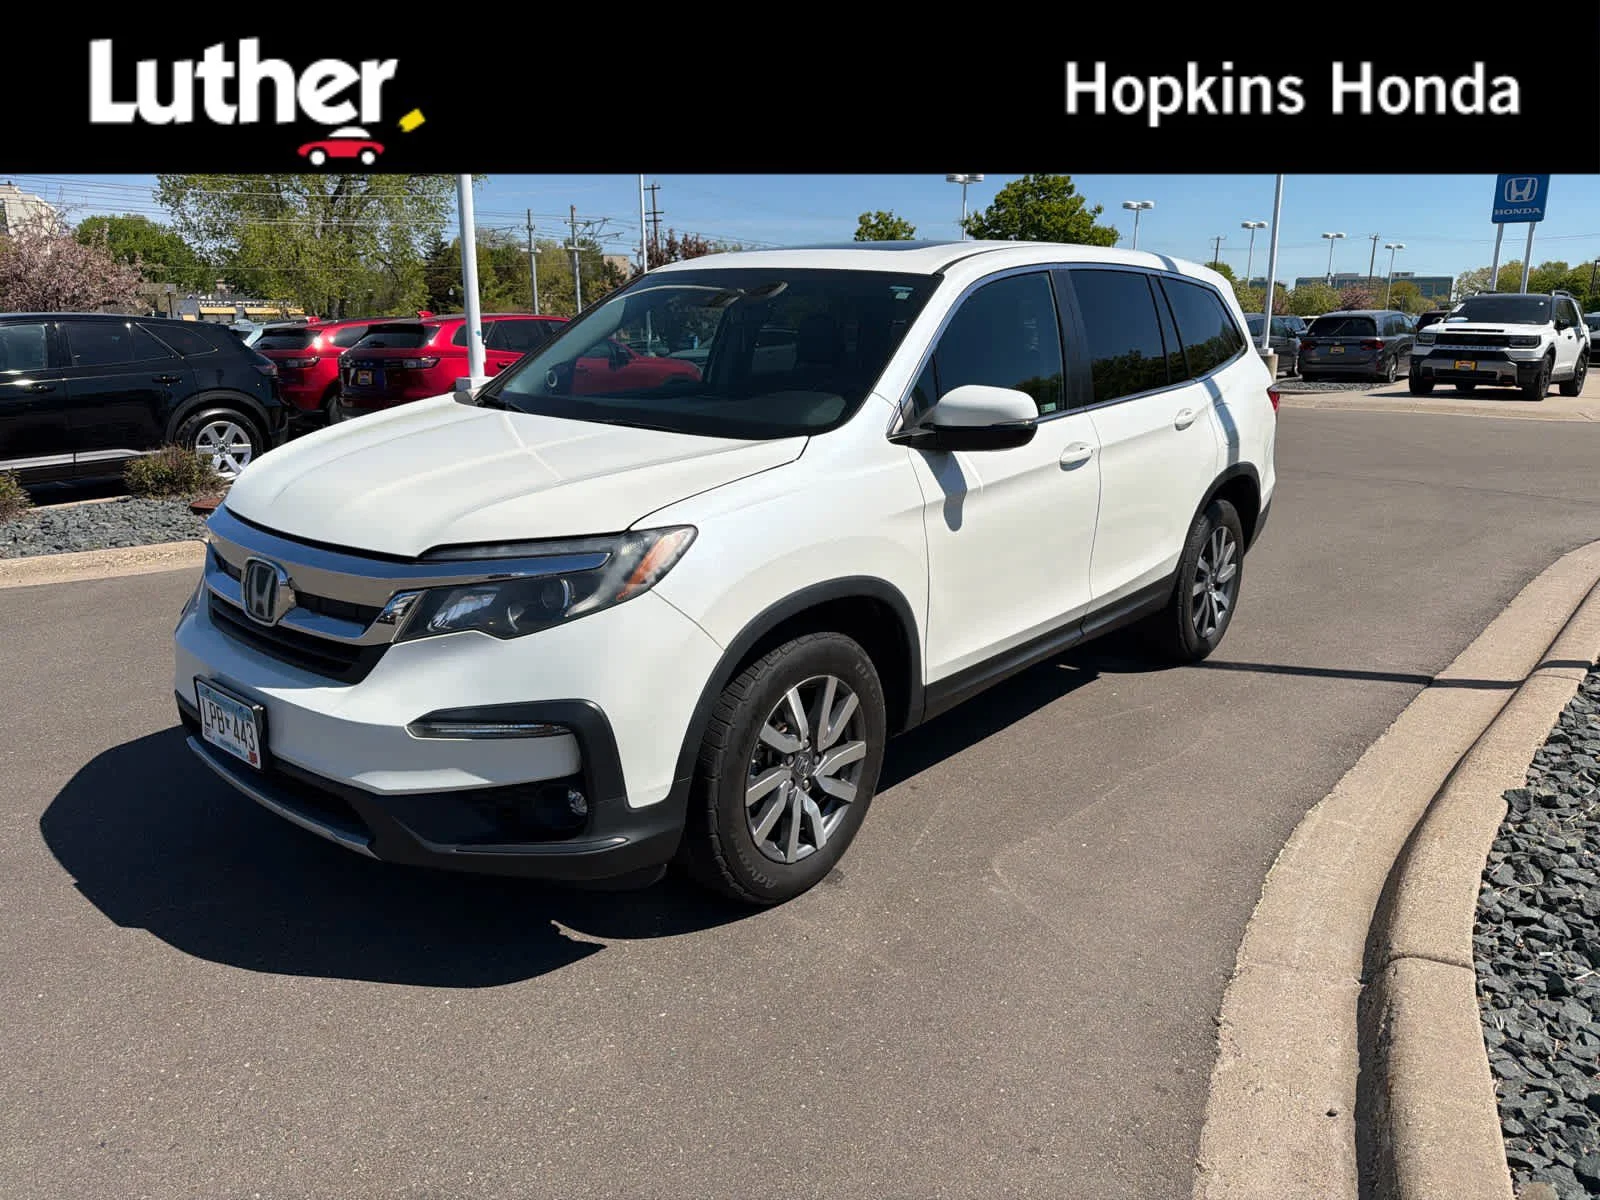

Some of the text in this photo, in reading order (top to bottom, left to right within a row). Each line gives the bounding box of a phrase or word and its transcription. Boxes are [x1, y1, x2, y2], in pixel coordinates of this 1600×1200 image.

[1494, 207, 1541, 216] HONDA
[201, 698, 225, 735] LPB
[233, 714, 256, 752] 443
